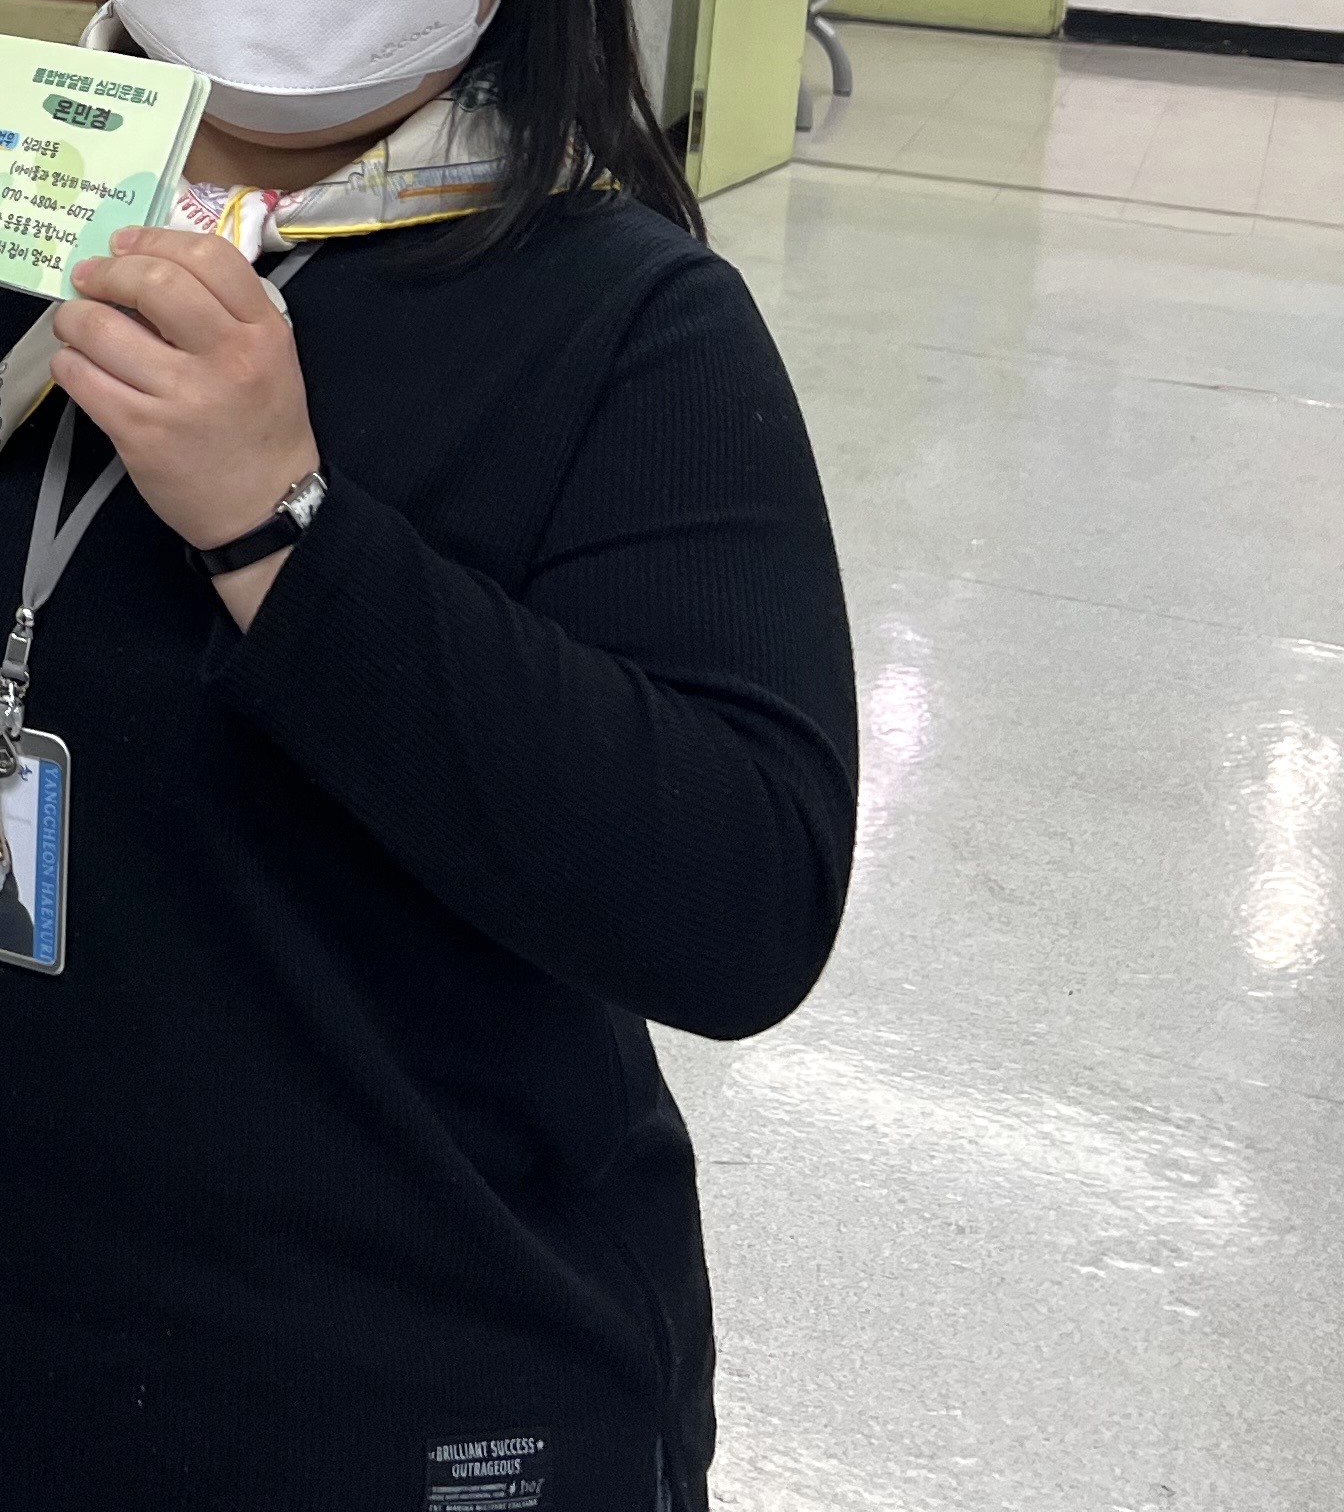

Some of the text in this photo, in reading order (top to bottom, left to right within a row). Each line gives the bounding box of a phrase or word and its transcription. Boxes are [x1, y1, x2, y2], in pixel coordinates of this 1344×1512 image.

[32, 67, 158, 106] 통합발달팀 심리운동사
[53, 99, 112, 130] 온민경
[22, 136, 60, 158] 심리운동
[51, 171, 80, 189] 열심히
[4, 213, 32, 236] 운동을
[32, 219, 79, 248] 잘합니다.
[8, 242, 30, 260] 집이
[31, 249, 64, 272] 멀어요.
[436, 1441, 488, 1462] BRILLIANT
[490, 1437, 535, 1458] SUCCESS
[452, 1458, 522, 1479] OUTRAGEOUS
